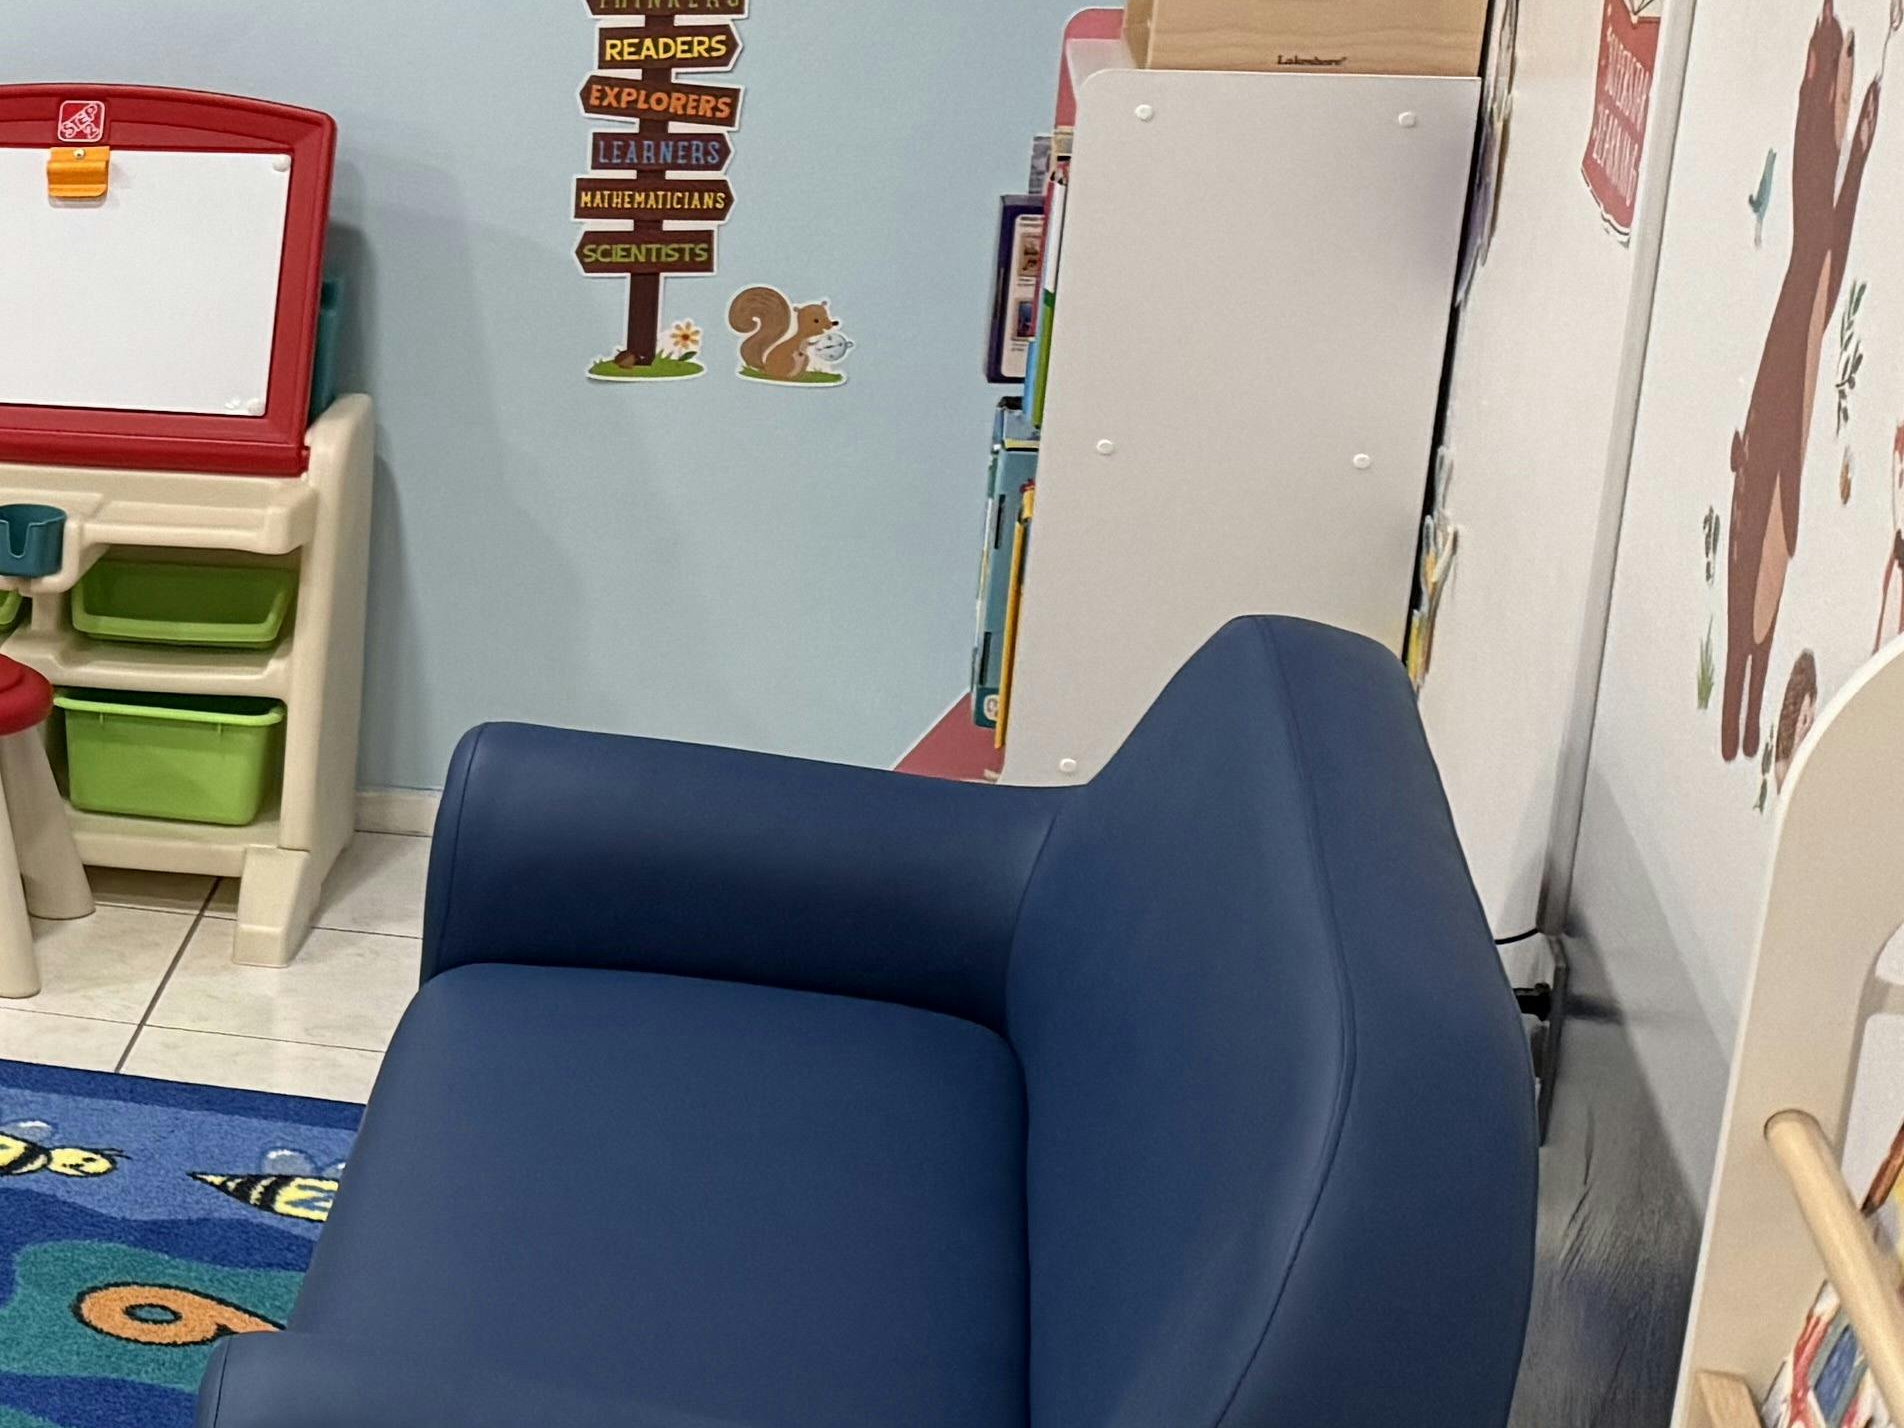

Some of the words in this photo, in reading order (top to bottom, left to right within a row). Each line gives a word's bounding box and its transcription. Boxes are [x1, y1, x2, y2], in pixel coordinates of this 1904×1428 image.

[605, 35, 727, 60] READERS
[589, 84, 733, 119] EXPLORERS
[62, 103, 98, 138] STEP
[599, 139, 721, 164] LEARNERS
[580, 190, 726, 209] MATHEMATICIANS
[583, 244, 708, 262] SCIENTISTS
